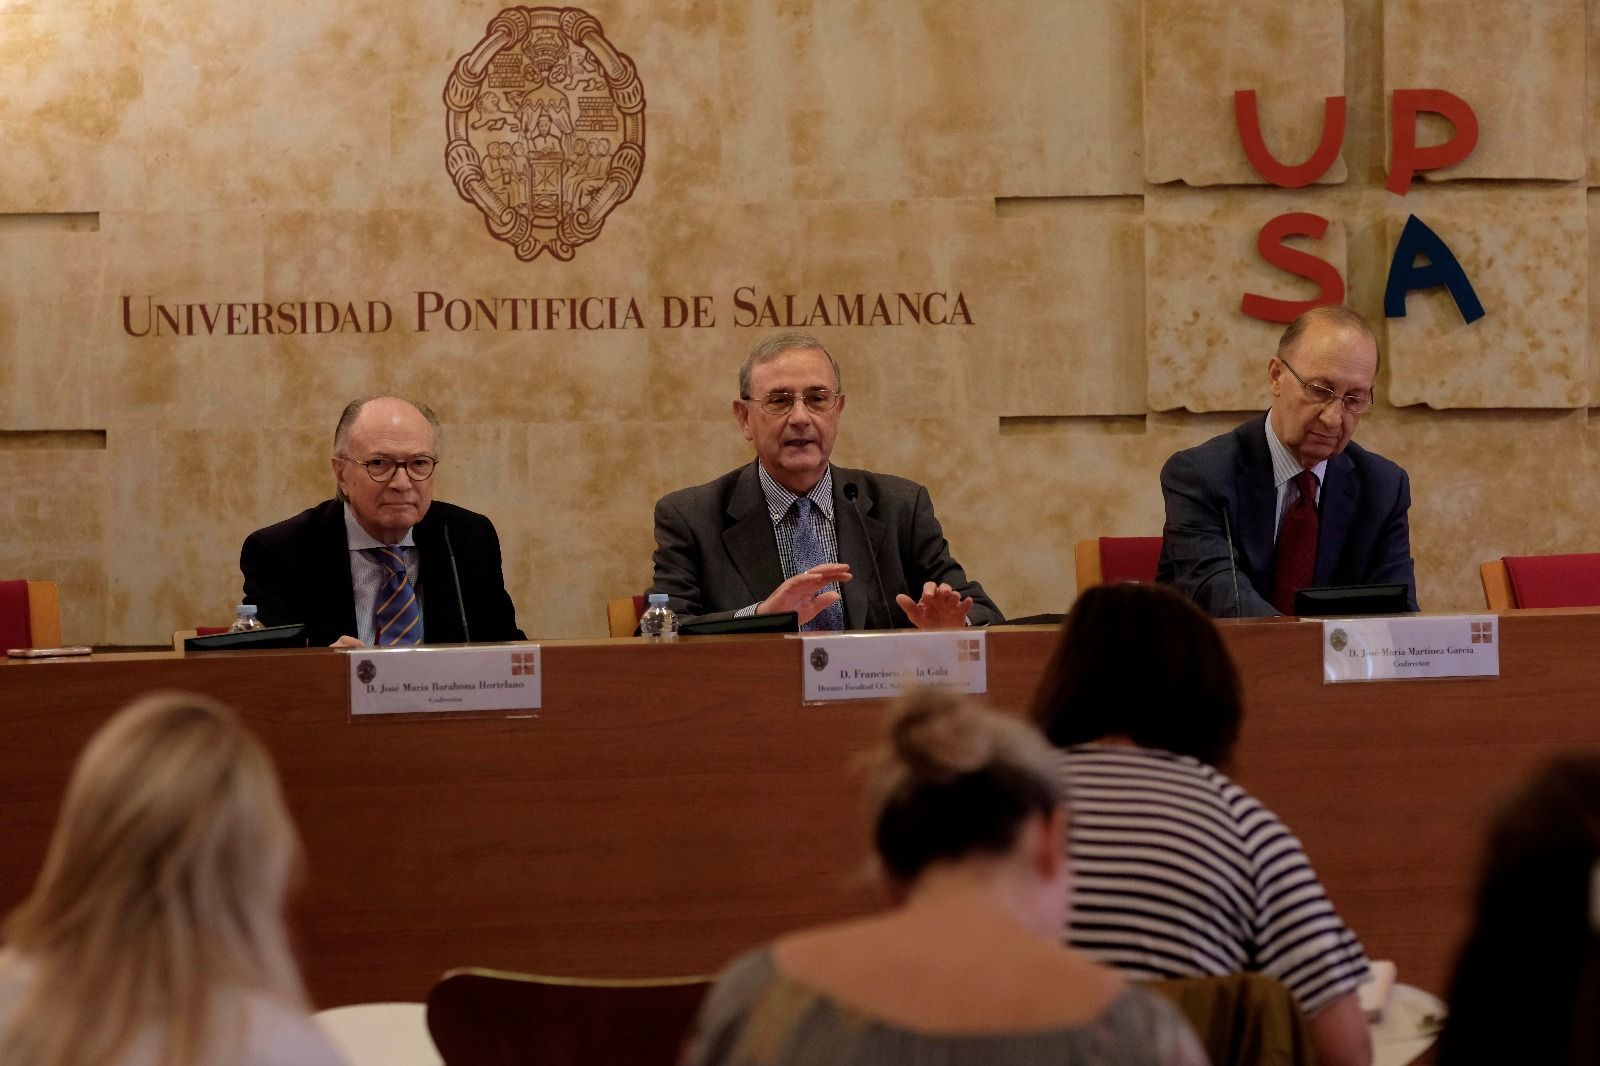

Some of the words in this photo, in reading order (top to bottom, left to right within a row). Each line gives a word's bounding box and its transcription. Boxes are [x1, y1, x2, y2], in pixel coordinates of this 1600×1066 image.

[122, 294, 393, 337] UNIVERSIDAD
[414, 291, 645, 332] PONTIFICIA
[661, 296, 716, 329] DE
[733, 286, 976, 328] SALAMANCA
[1349, 648, 1359, 657] D.
[1393, 660, 1431, 668] Codirector
[840, 670, 851, 680] D.
[854, 668, 900, 679] Francisco
[916, 667, 925, 677] la
[366, 684, 377, 694] D.
[432, 681, 476, 692] Barahona
[479, 680, 525, 690] Hortelano
